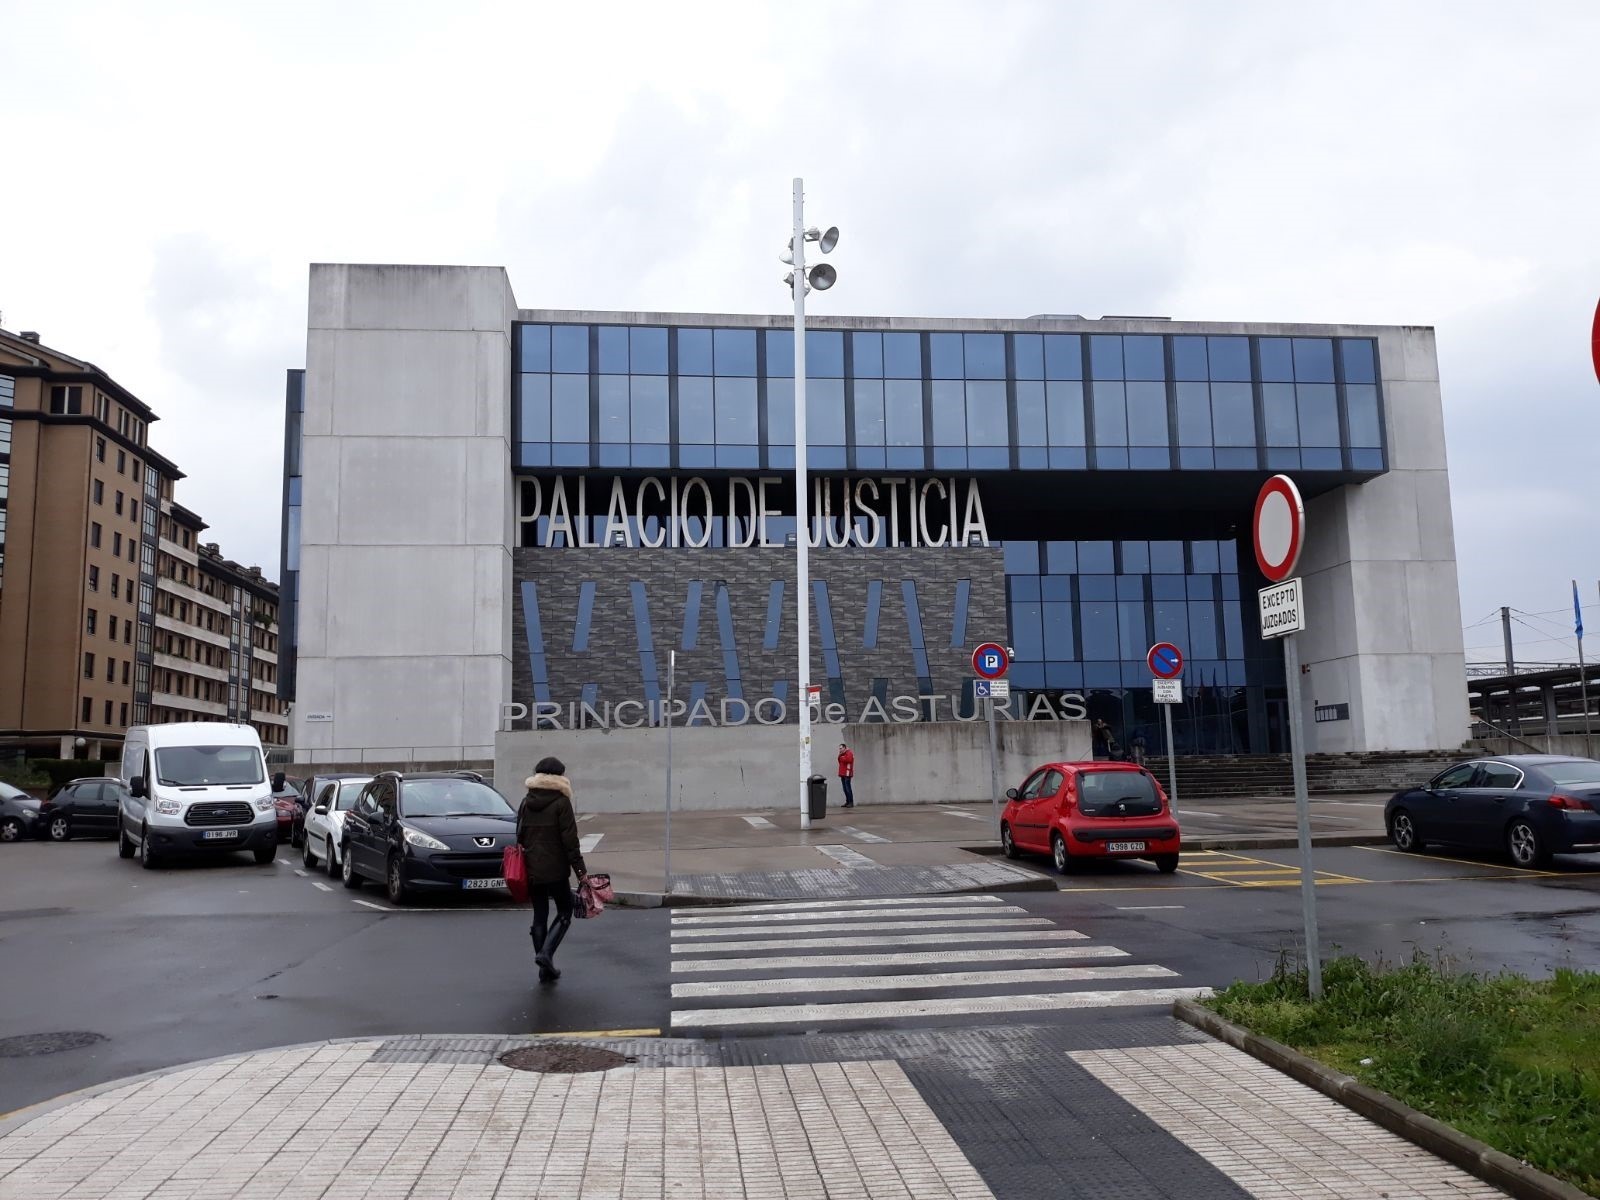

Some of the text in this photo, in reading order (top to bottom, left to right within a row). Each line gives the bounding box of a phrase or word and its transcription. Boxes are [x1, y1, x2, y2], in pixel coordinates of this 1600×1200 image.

[515, 475, 990, 548] PALACIO DE JUSTICIA
[1262, 588, 1295, 609] EXCEPTO
[1263, 609, 1297, 629] JUZGADOS
[987, 656, 996, 667] P
[502, 694, 1087, 731] PRINCIPADO de ASTURIAS
[1110, 843, 1128, 851] 4998
[467, 880, 488, 888] 2823
